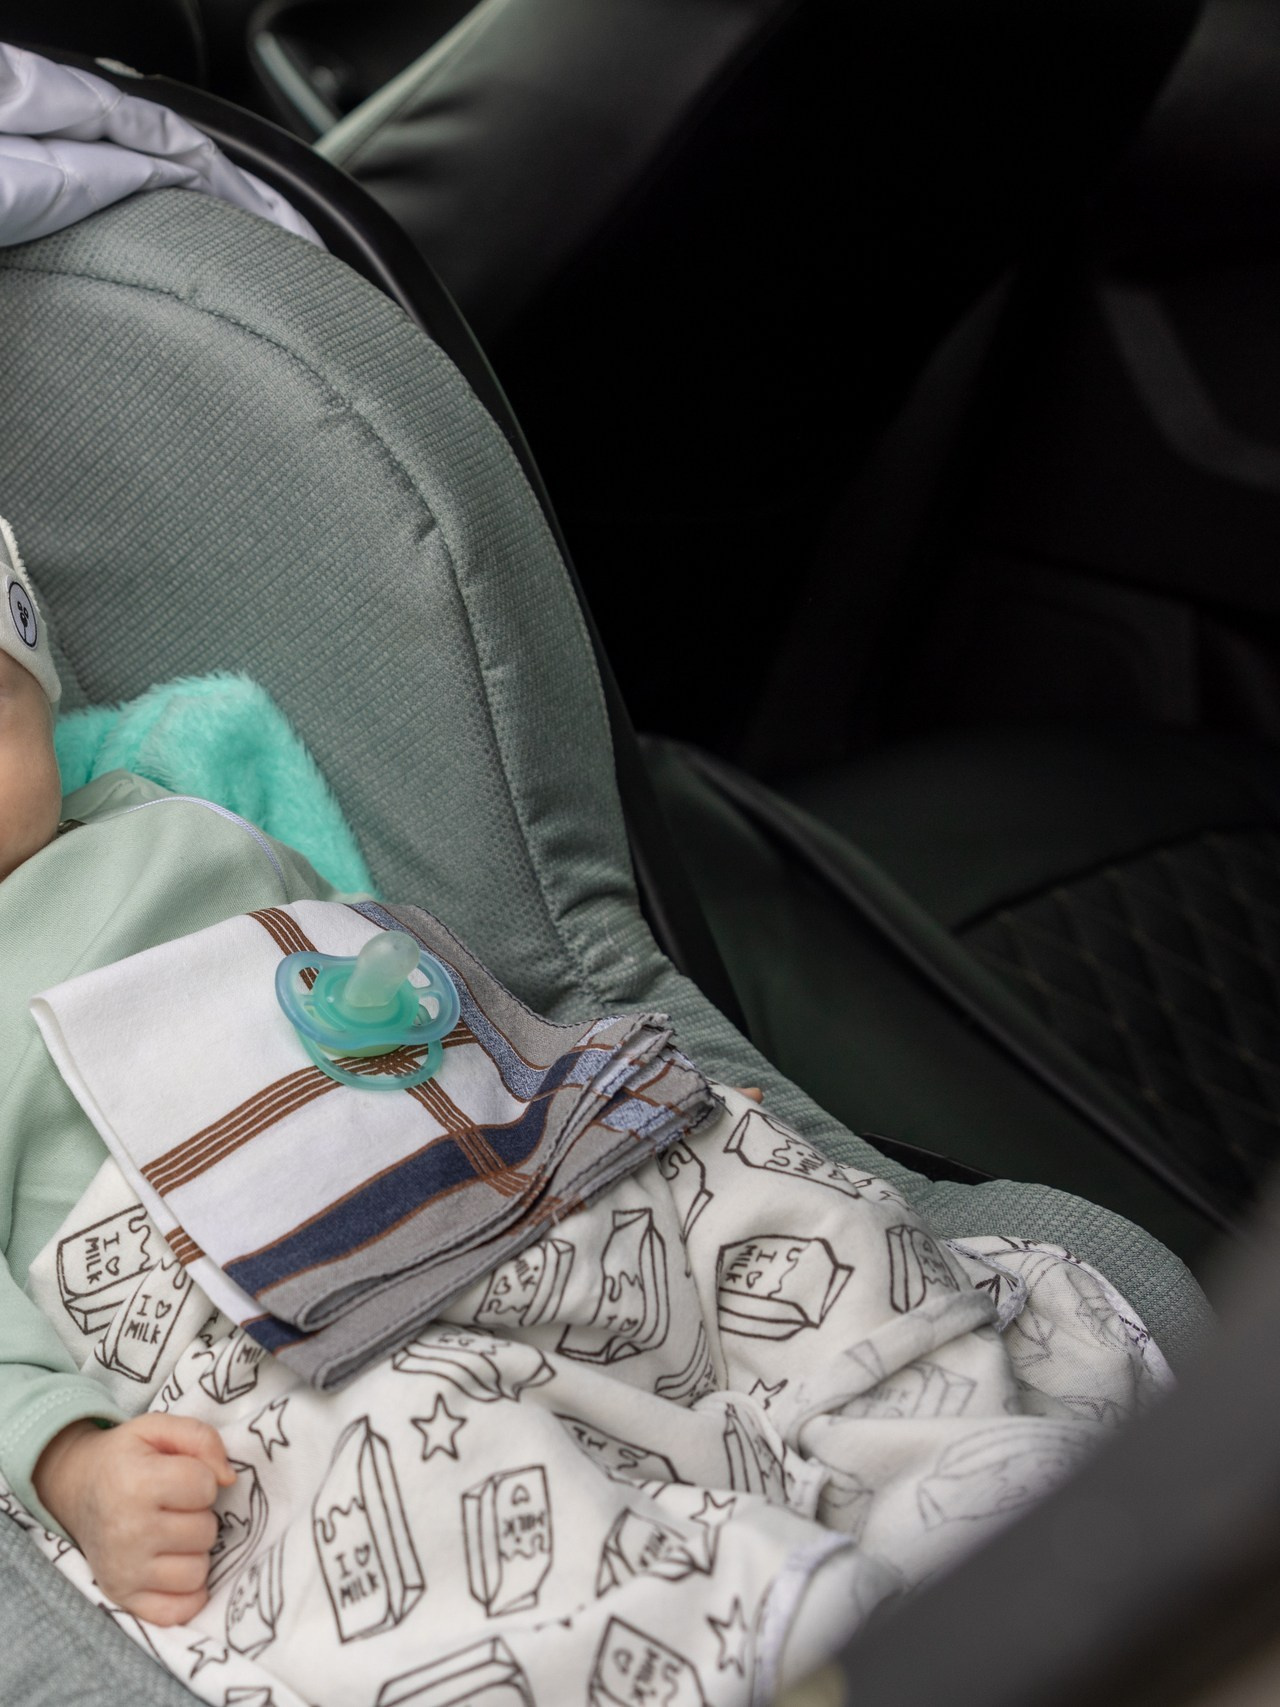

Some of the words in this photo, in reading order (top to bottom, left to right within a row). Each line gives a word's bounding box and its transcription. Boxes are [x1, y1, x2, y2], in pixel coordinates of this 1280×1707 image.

[84, 1236, 103, 1285] MILK
[725, 1244, 758, 1283] MILK
[136, 1294, 152, 1316] I
[124, 1320, 161, 1345] MILK
[340, 1572, 379, 1609] MILK
